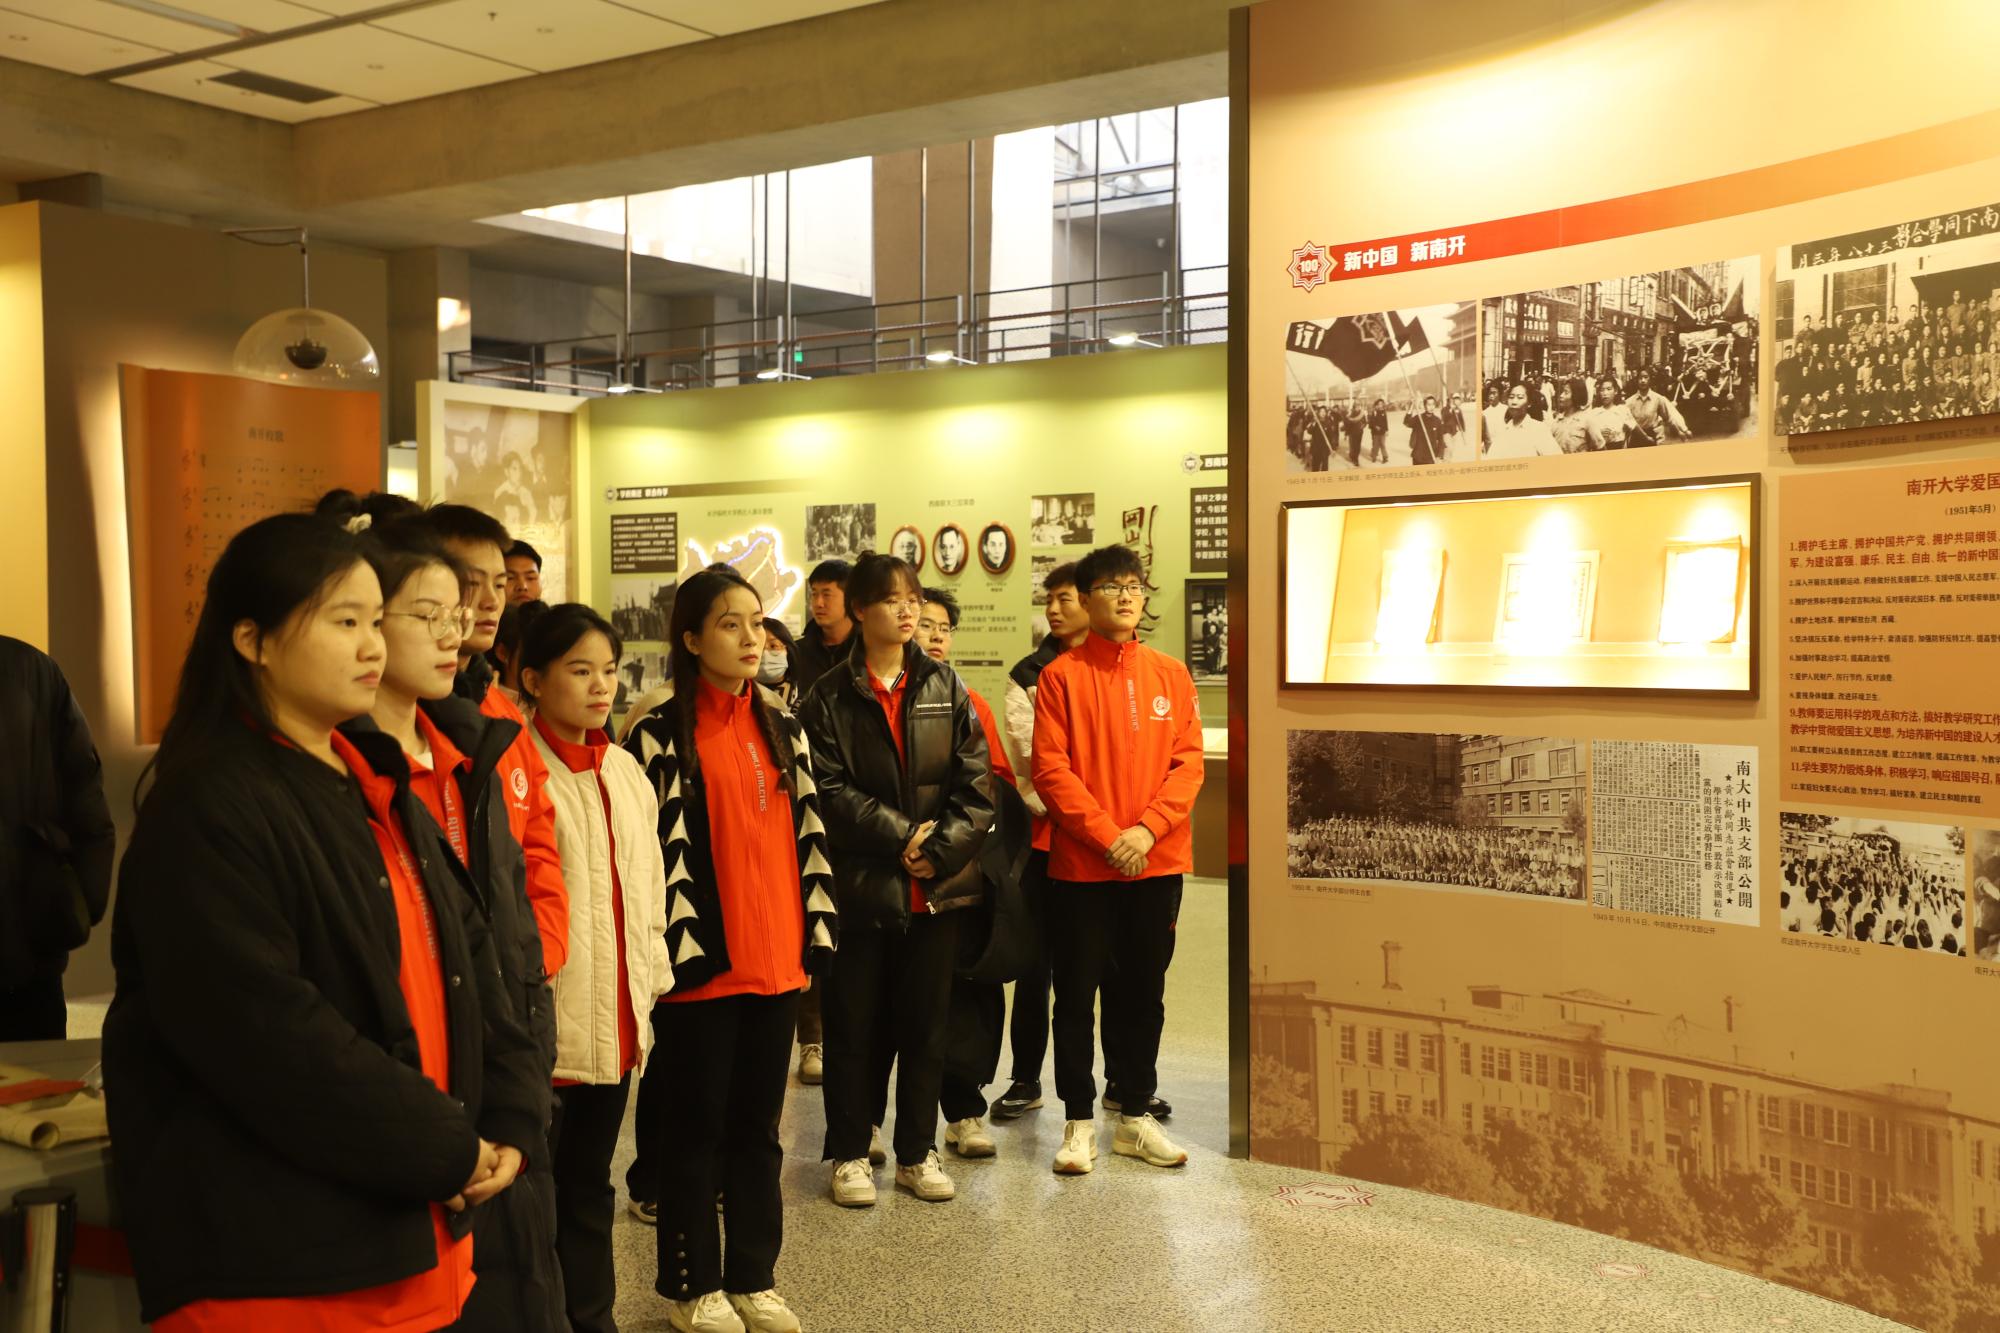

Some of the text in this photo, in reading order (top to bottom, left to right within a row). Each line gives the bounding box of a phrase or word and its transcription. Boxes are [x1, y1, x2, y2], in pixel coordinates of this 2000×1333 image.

[1299, 259, 1319, 272] 100
[1344, 235, 1466, 271] 新中国 新南开
[1906, 472, 2000, 497] 南开大学爱国
[1736, 760, 1752, 909] 南大中共支部公開
